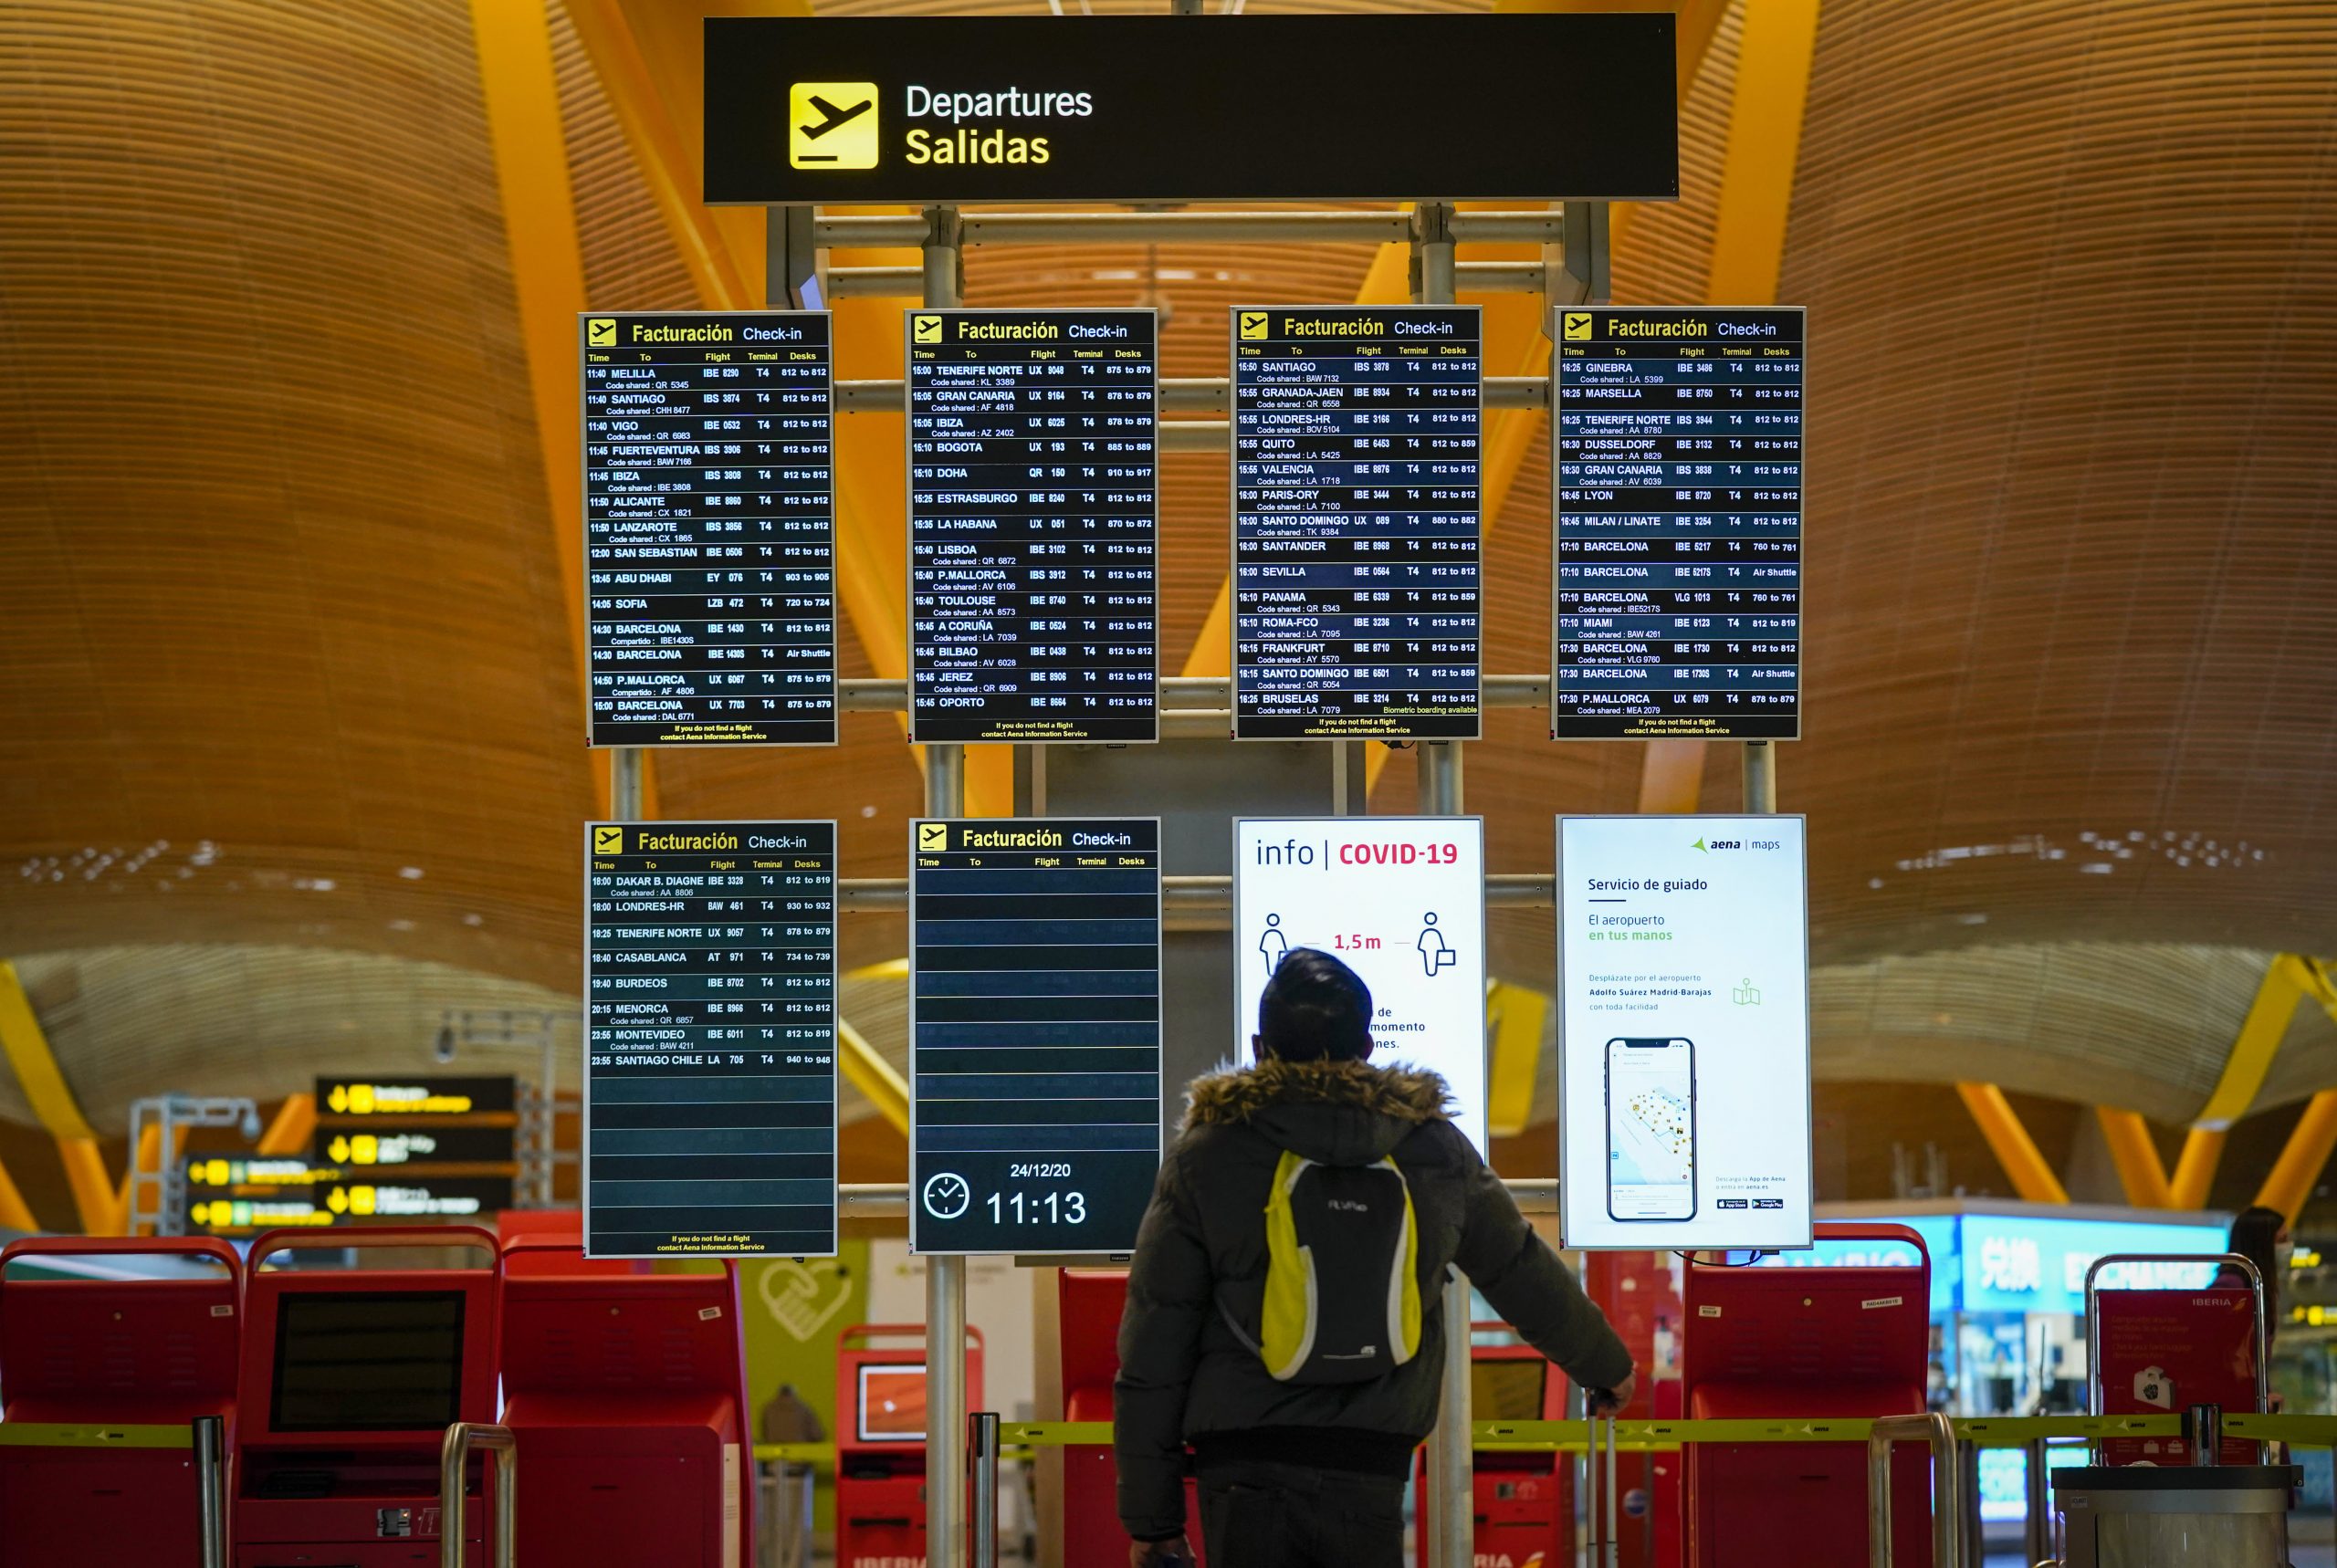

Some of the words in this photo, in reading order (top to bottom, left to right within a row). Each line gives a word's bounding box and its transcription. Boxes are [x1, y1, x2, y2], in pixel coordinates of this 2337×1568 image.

[907, 85, 1093, 124] Departures
[907, 130, 1049, 163] Salidas
[634, 324, 732, 340] Facturación
[743, 327, 802, 340] Check-in
[959, 321, 1057, 339] Facturación
[1069, 325, 1127, 337] Check-in
[1285, 319, 1383, 335] Facturación
[1395, 322, 1452, 334] Check-in
[1609, 319, 1706, 336] Facturación
[1718, 323, 1776, 335] Check-in
[706, 352, 730, 362] Flight
[748, 352, 778, 361] Terminal
[588, 369, 606, 377] 11:40
[612, 370, 655, 378] MELILLA
[704, 369, 718, 377] IBE
[723, 368, 739, 377] 8290
[757, 368, 769, 376] T4
[1239, 388, 1257, 396] 15:55
[1263, 388, 1343, 396] GRANADA-JAEN
[1355, 388, 1369, 396] IBE
[1373, 388, 1389, 396] 8934
[1407, 387, 1420, 396] T4
[1451, 388, 1459, 396] to
[1562, 440, 1579, 449] 16:30
[1586, 439, 1655, 449] DUSSELDORF
[1677, 440, 1692, 448] IBE
[1696, 440, 1712, 448] 3132
[1730, 440, 1741, 448] T4
[915, 546, 933, 554] 15:40
[938, 545, 977, 554] LISBOA
[1030, 545, 1044, 553] IBE
[1049, 545, 1065, 553] 3102
[1083, 544, 1095, 553] T4
[1126, 545, 1135, 553] to
[1137, 546, 1152, 554] 812
[1561, 593, 1578, 601] 17:10
[1584, 593, 1648, 601] BARCELONA
[1675, 593, 1690, 601] VLG
[1694, 593, 1710, 601] 1013
[1728, 593, 1739, 601] T4
[592, 600, 611, 608] 14:05
[616, 599, 647, 609] SOFIA
[707, 599, 723, 607] LZB
[729, 599, 743, 607] 472
[760, 598, 773, 607] T4
[1240, 643, 1258, 653] 16:15
[1263, 643, 1325, 653] FRANKFURT
[1355, 643, 1368, 652] IBE
[1373, 643, 1389, 652] 8710
[1407, 643, 1419, 652] T4
[1417, 706, 1446, 715] boarding
[640, 832, 737, 850] Facturación
[749, 836, 806, 848] Check-in
[964, 830, 1062, 846] Facturación
[1073, 833, 1131, 845] Check-in
[1753, 841, 1779, 851] maps
[1258, 840, 1313, 864] info
[1340, 843, 1457, 863] COVID-19
[1588, 879, 1639, 890] Servicio
[1644, 879, 1659, 890] de
[1664, 879, 1707, 893] guiado
[1589, 915, 1598, 925] El
[1603, 915, 1664, 927] aeropuerto
[1609, 931, 1627, 940] tus
[1335, 934, 1362, 950] 1,5
[1366, 937, 1380, 949] m
[1589, 974, 1632, 983] Desplázate
[1378, 1008, 1391, 1017] de
[592, 1030, 611, 1039] 23:55
[616, 1030, 685, 1039] MONTEVIDEO
[708, 1030, 723, 1039] IBE
[728, 1030, 743, 1039] 6011
[761, 1030, 773, 1039] T4
[1011, 1164, 1070, 1177] 24/12/20
[988, 1192, 1085, 1223] 11:13
